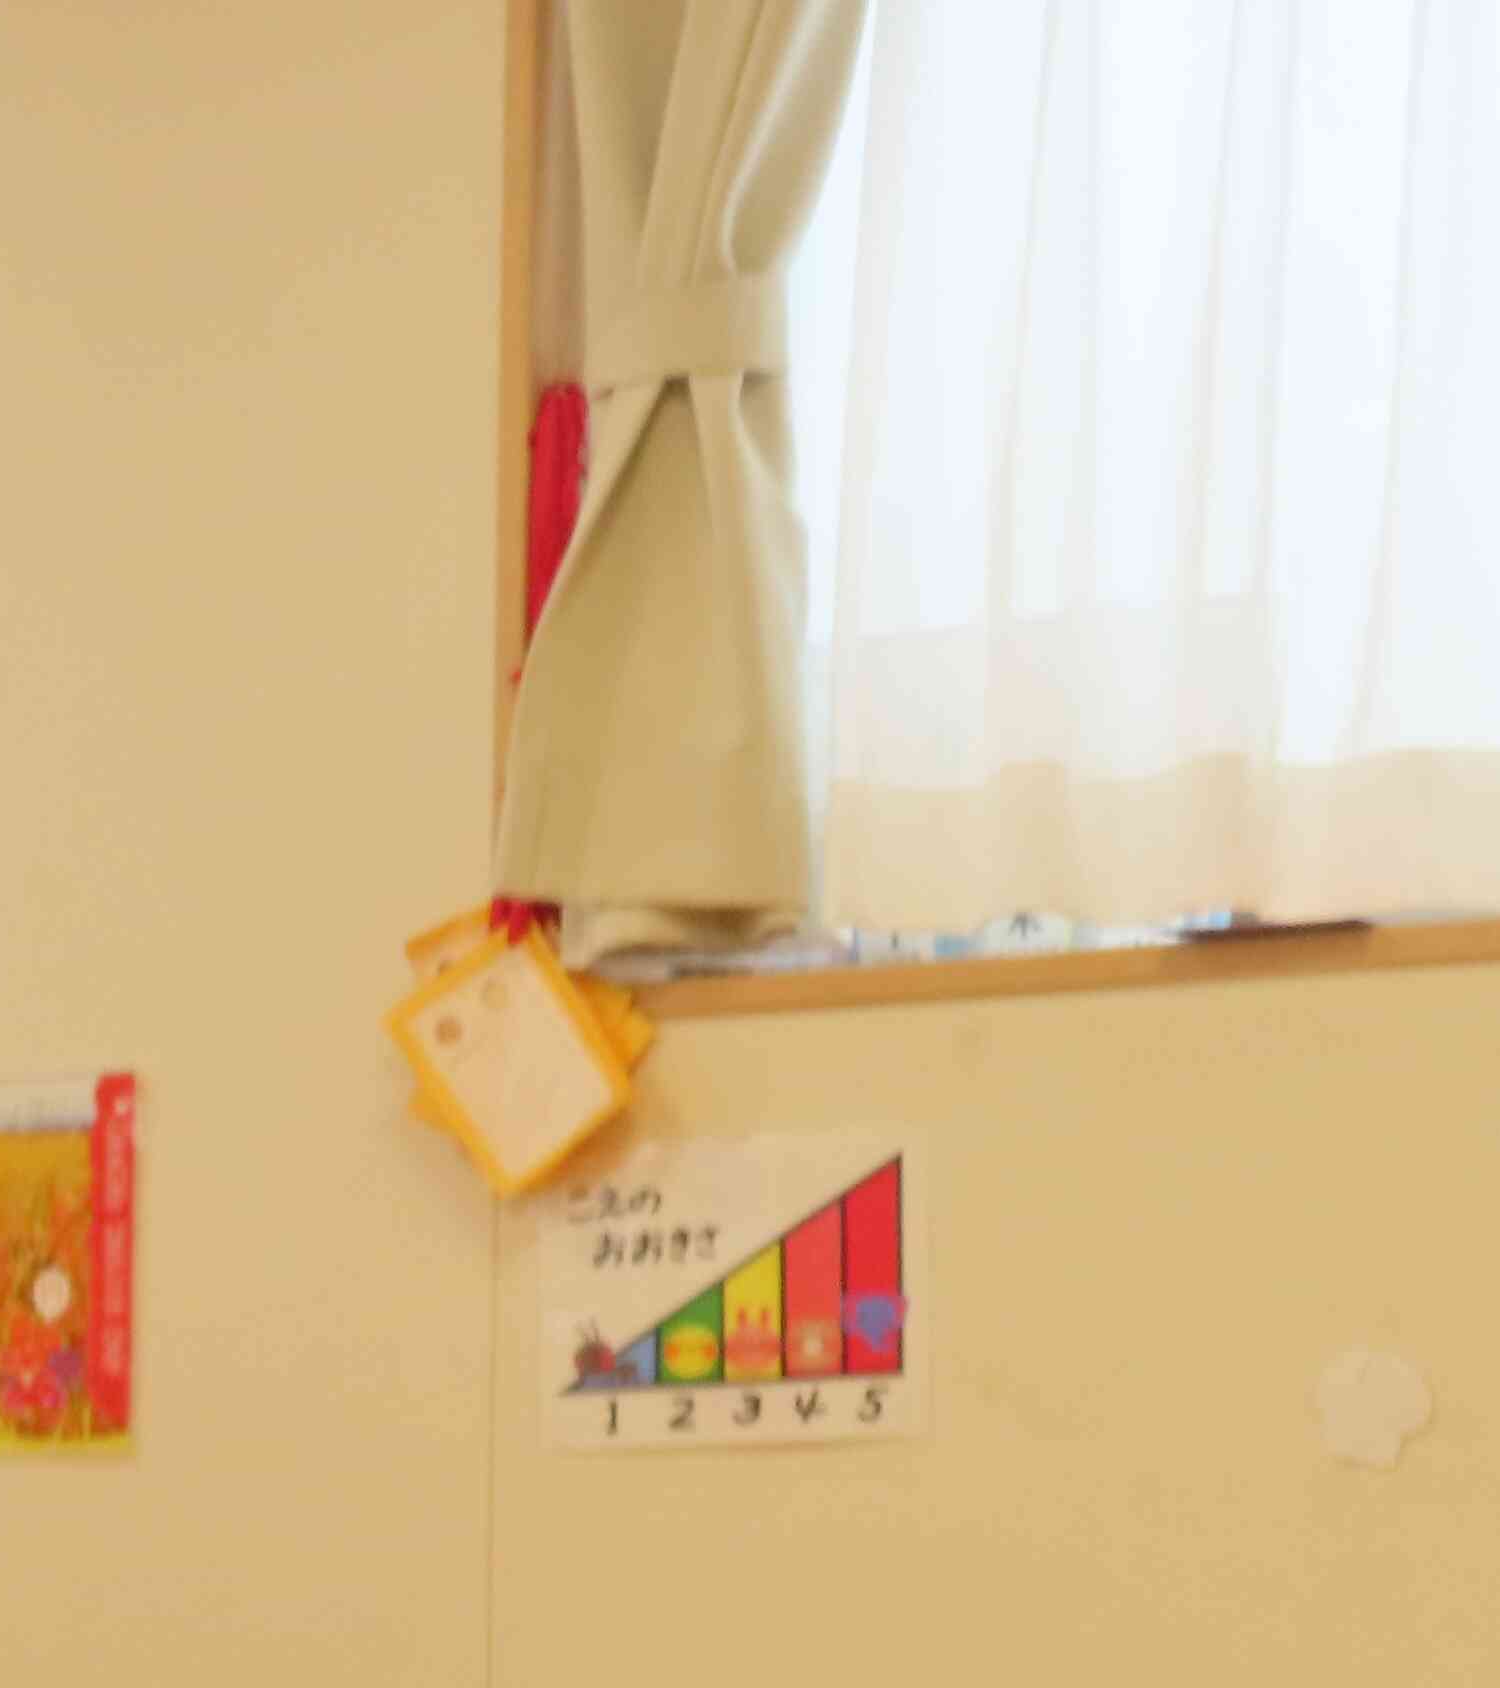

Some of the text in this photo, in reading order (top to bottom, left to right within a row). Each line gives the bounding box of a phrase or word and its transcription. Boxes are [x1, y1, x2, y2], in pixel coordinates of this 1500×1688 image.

[592, 1225, 719, 1267] おおきさ
[605, 1387, 888, 1436] 1 2 3 4 5
